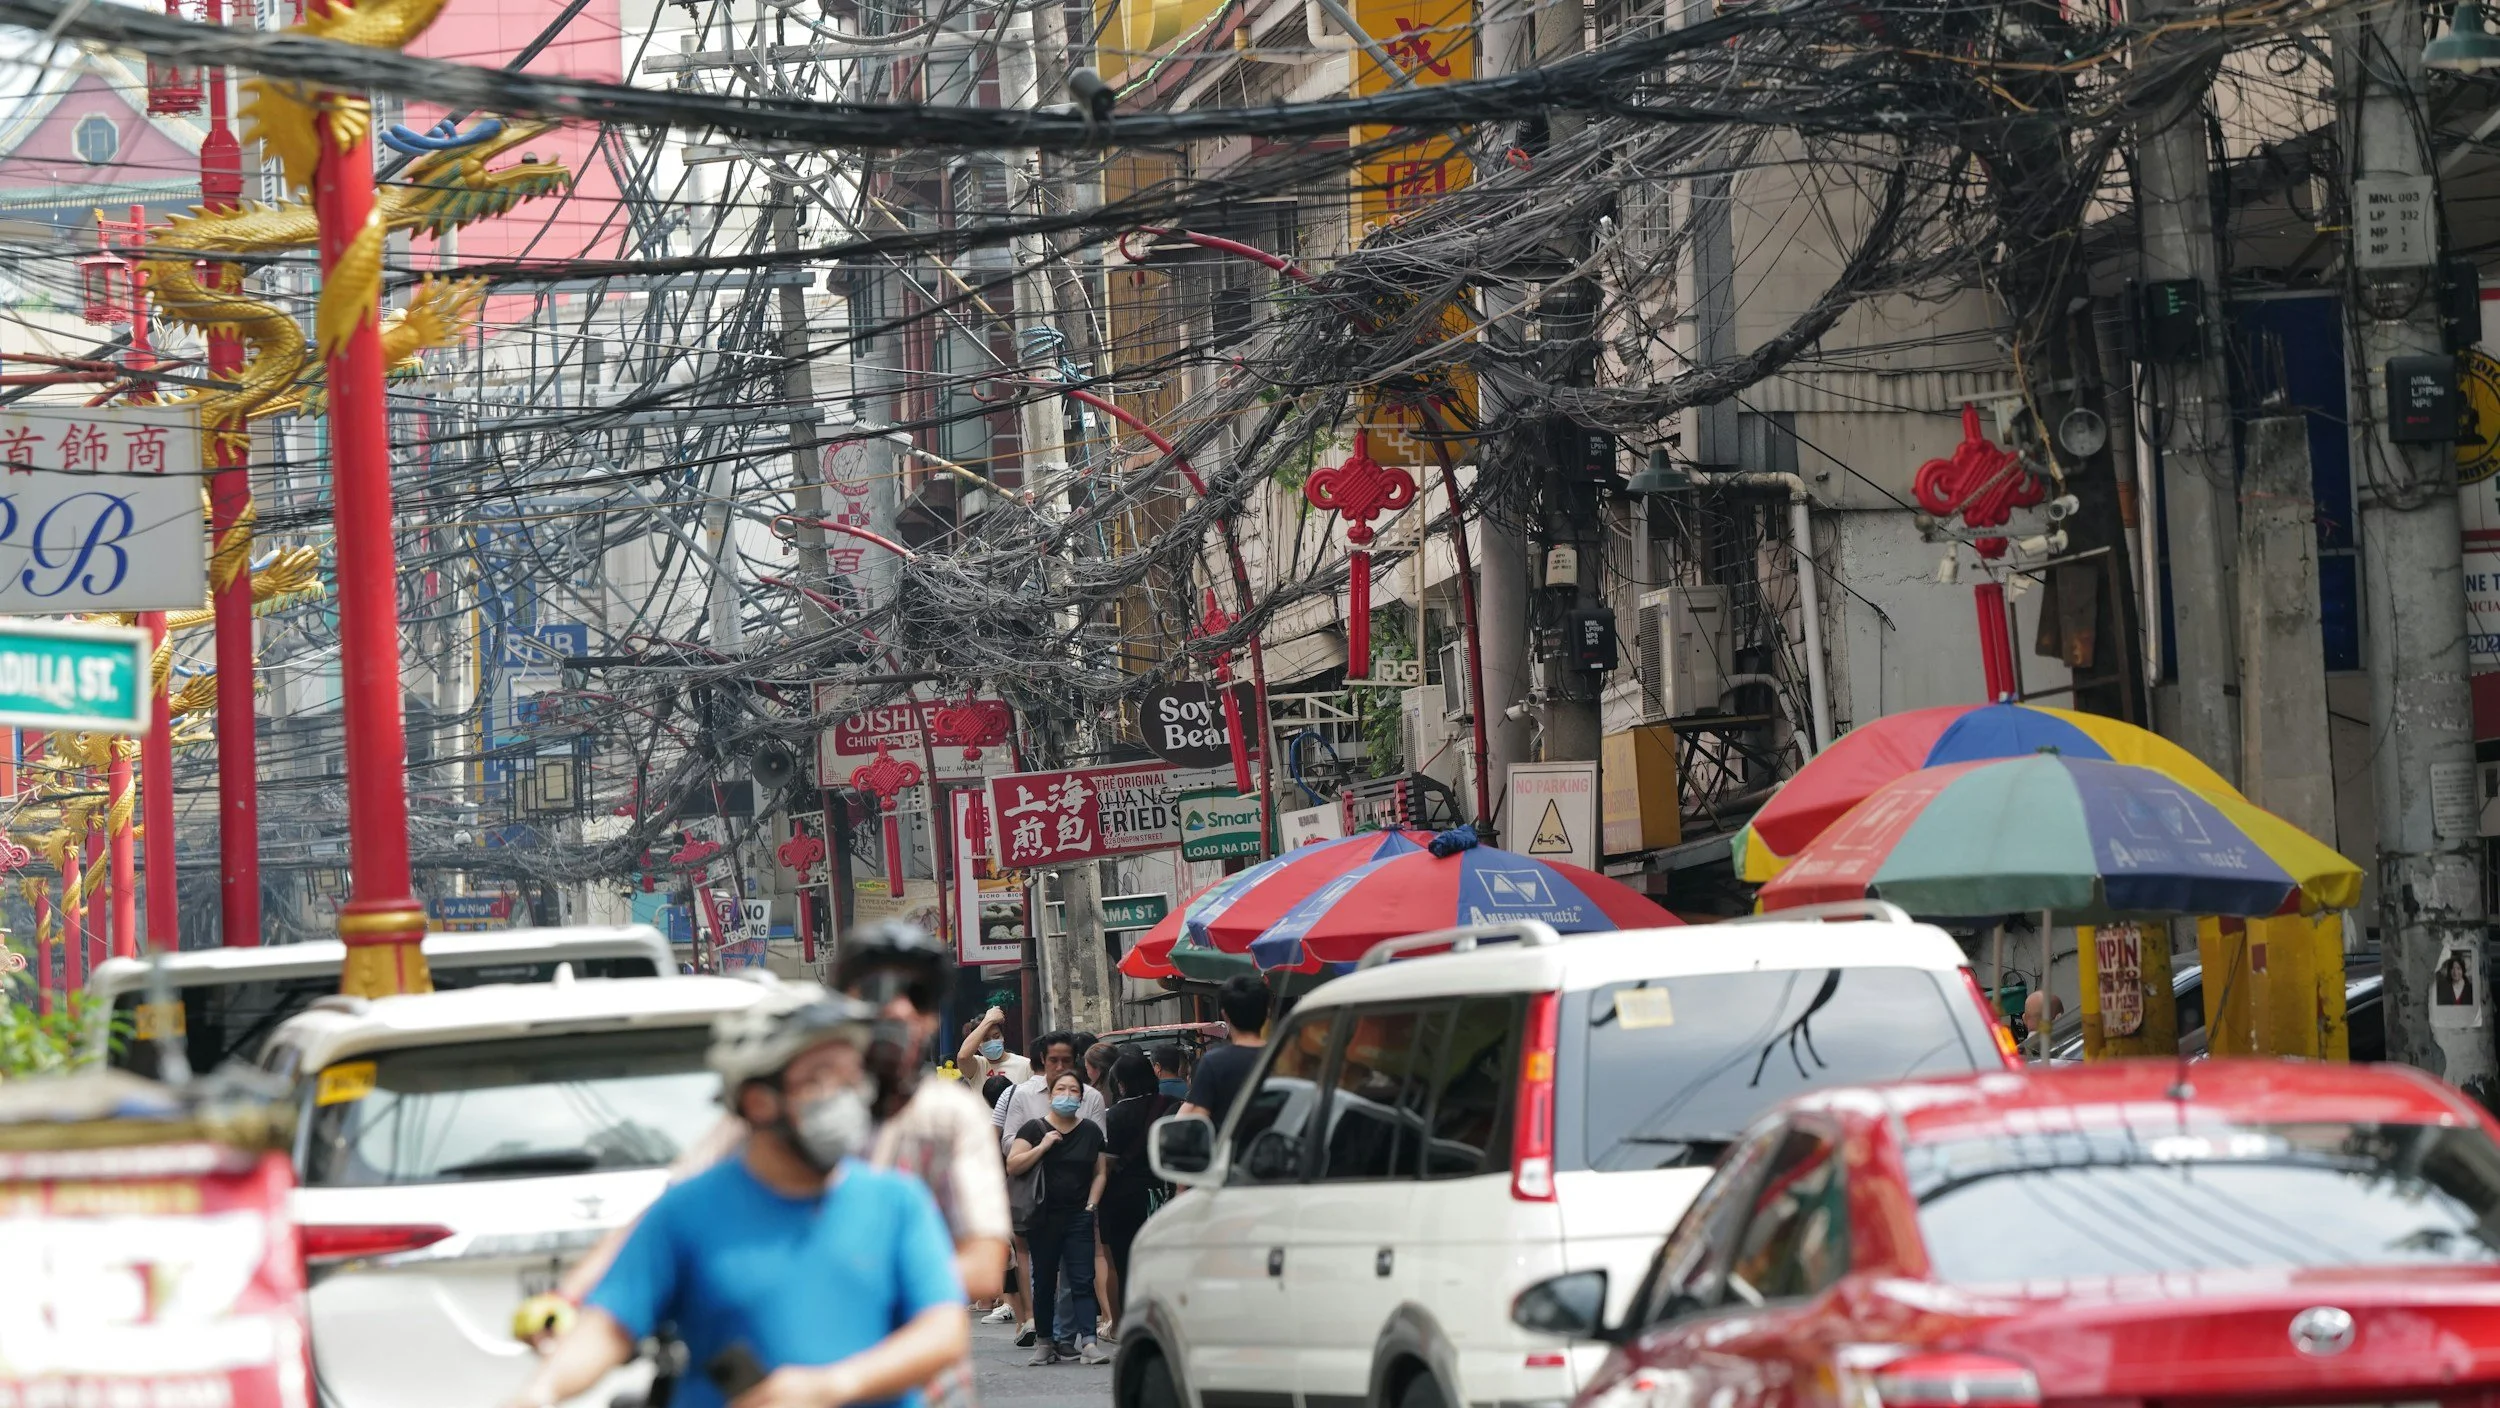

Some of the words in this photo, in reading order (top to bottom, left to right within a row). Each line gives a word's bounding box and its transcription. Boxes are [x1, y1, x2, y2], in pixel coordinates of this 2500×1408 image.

[2368, 192, 2395, 204] MNL
[2398, 191, 2420, 202] 003
[2369, 210, 2385, 221] LP
[2370, 227, 2388, 238] NP
[2371, 243, 2389, 254] NP
[2401, 241, 2408, 253] 2
[0, 422, 170, 477] 首飾商
[2465, 573, 2487, 592] NE
[2468, 634, 2500, 653] 202
[77, 655, 119, 702] ST.
[844, 707, 941, 734] OISHIE
[1158, 696, 1216, 726] Soy
[1095, 778, 1115, 791] THE
[1117, 773, 1168, 789] ORIGINAL
[1515, 779, 1533, 795] NO
[1536, 778, 1589, 795] PARKING
[1003, 774, 1094, 818] 上海
[1096, 786, 1180, 811] SHANG
[1099, 805, 1167, 834] FRIED
[1171, 804, 1181, 828] S
[1207, 807, 1262, 828] Smart
[1011, 814, 1093, 861] 煎包
[1140, 832, 1163, 842] STREET
[1186, 843, 1219, 857] LOAD
[1221, 842, 1238, 854] NA
[468, 903, 491, 916] Nigh
[740, 904, 765, 920] NO
[1102, 906, 1133, 923] AMA
[1135, 904, 1157, 920] ST.
[2098, 937, 2138, 970] NPIN
